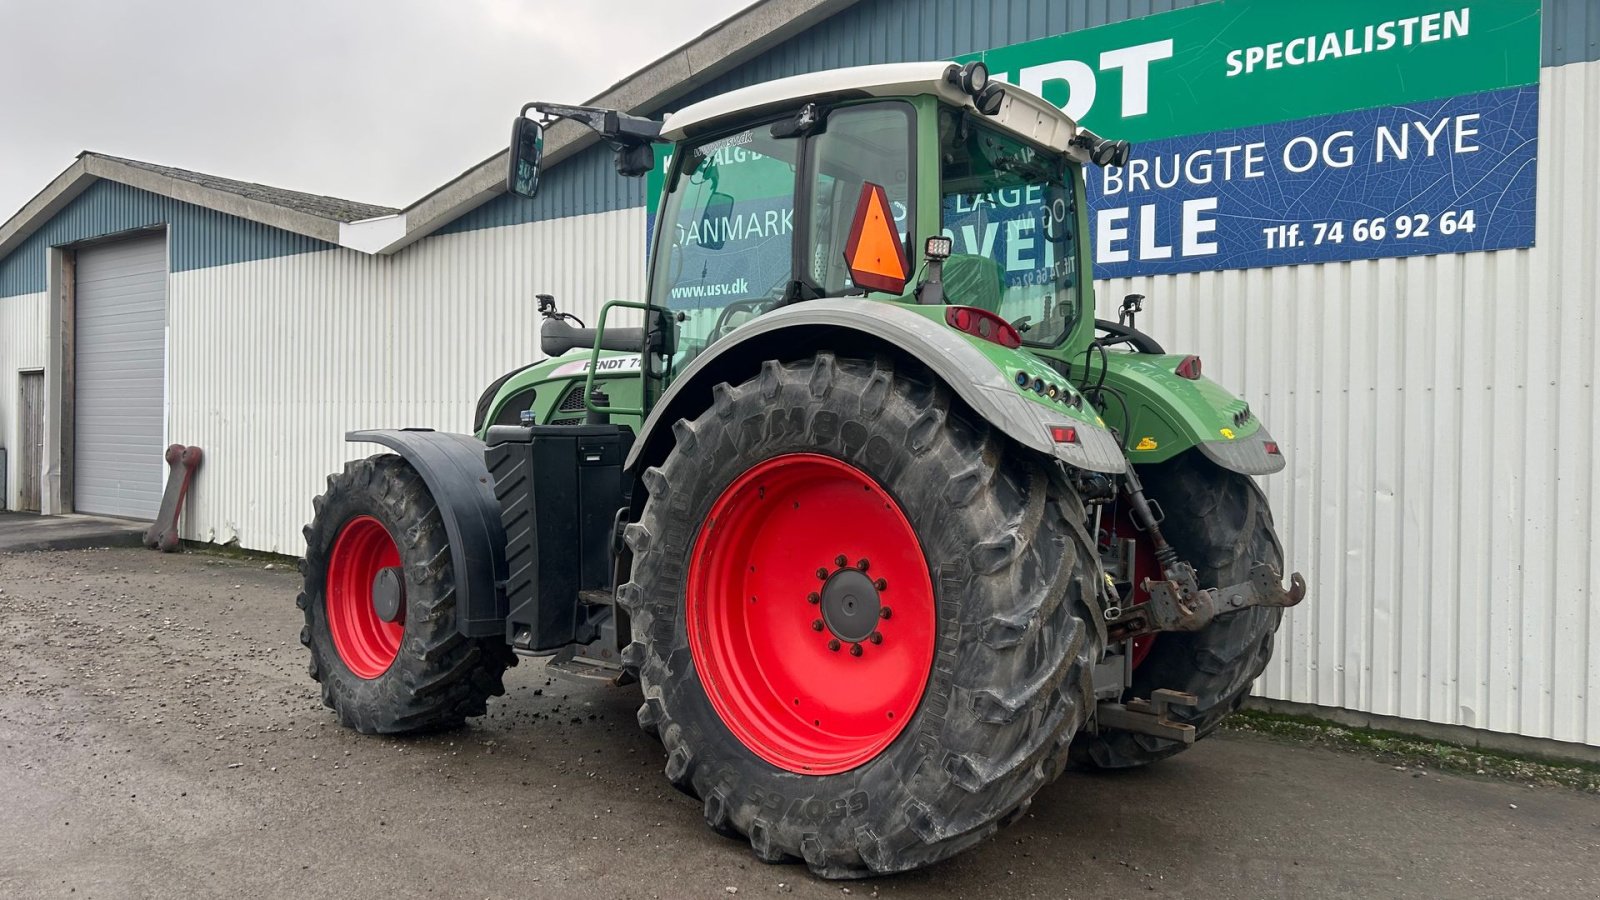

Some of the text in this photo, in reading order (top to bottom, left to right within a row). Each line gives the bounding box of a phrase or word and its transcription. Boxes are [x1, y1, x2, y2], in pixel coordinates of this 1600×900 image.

[1226, 8, 1469, 77] SPECIALISTEN
[1103, 142, 1266, 195] BRUGTE
[1283, 131, 1354, 173] OG
[1376, 113, 1480, 164] NYE
[1263, 209, 1476, 249] Tlf. 74 66 92 64
[671, 278, 749, 299] www.usv.dk
